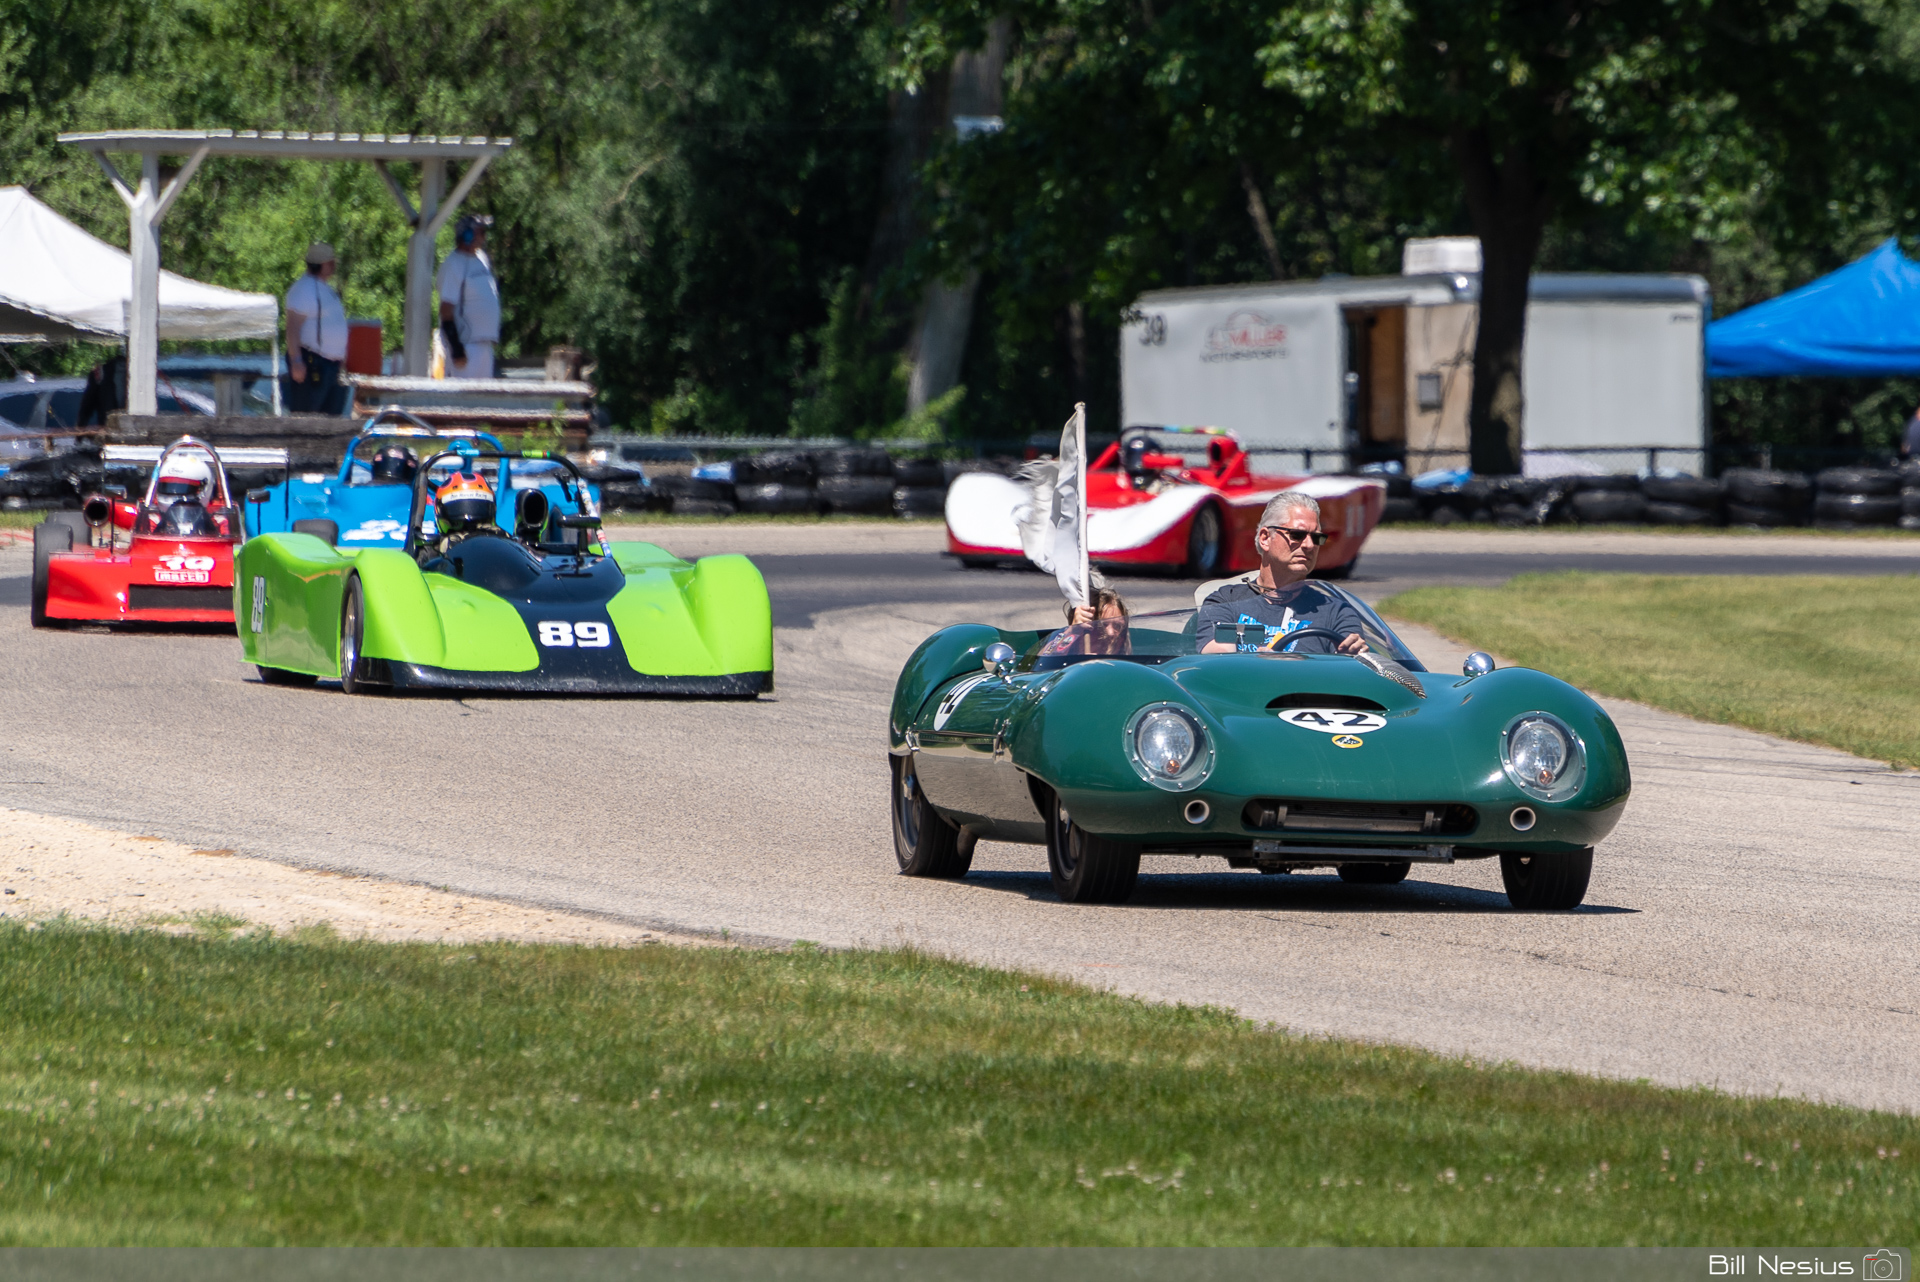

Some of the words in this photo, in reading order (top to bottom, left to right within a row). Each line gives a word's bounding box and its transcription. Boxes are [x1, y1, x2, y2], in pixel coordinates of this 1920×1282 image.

[251, 575, 265, 634] 89
[537, 621, 611, 648] 89
[1291, 711, 1380, 727] 42
